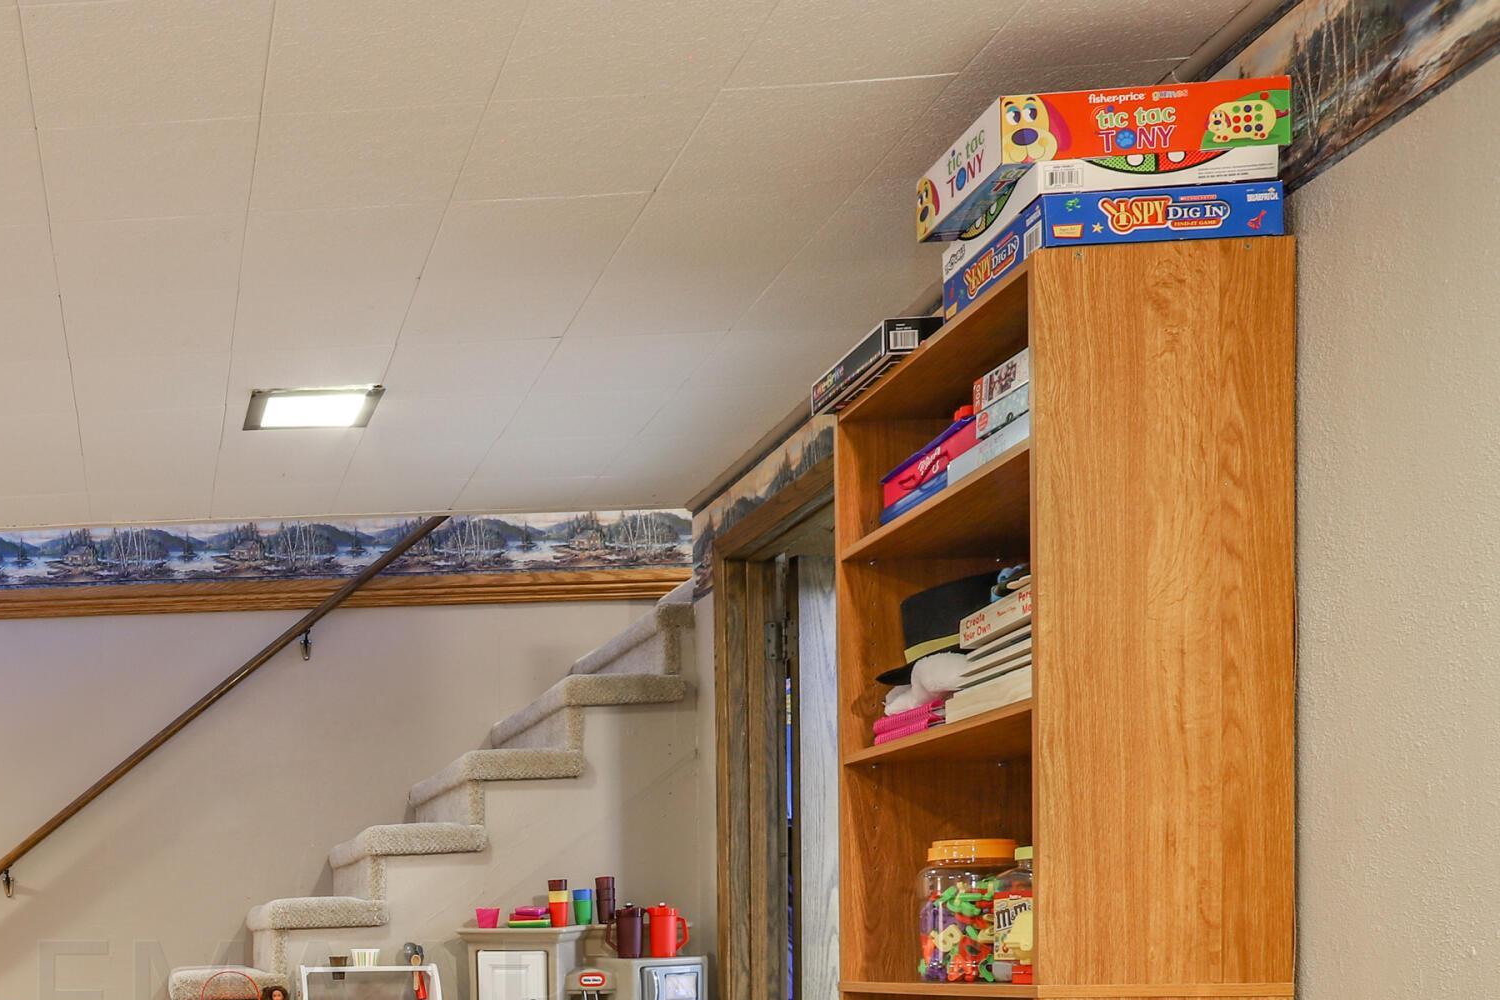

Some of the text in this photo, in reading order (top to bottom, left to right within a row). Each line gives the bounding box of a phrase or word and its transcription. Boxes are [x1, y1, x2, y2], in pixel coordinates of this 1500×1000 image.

[1088, 92, 1146, 104] fisher-price
[1096, 105, 1176, 129] tic tac
[965, 129, 985, 159] tac
[1131, 200, 1166, 225] SPY
[965, 613, 985, 629] Create
[963, 623, 991, 642] Your Own
